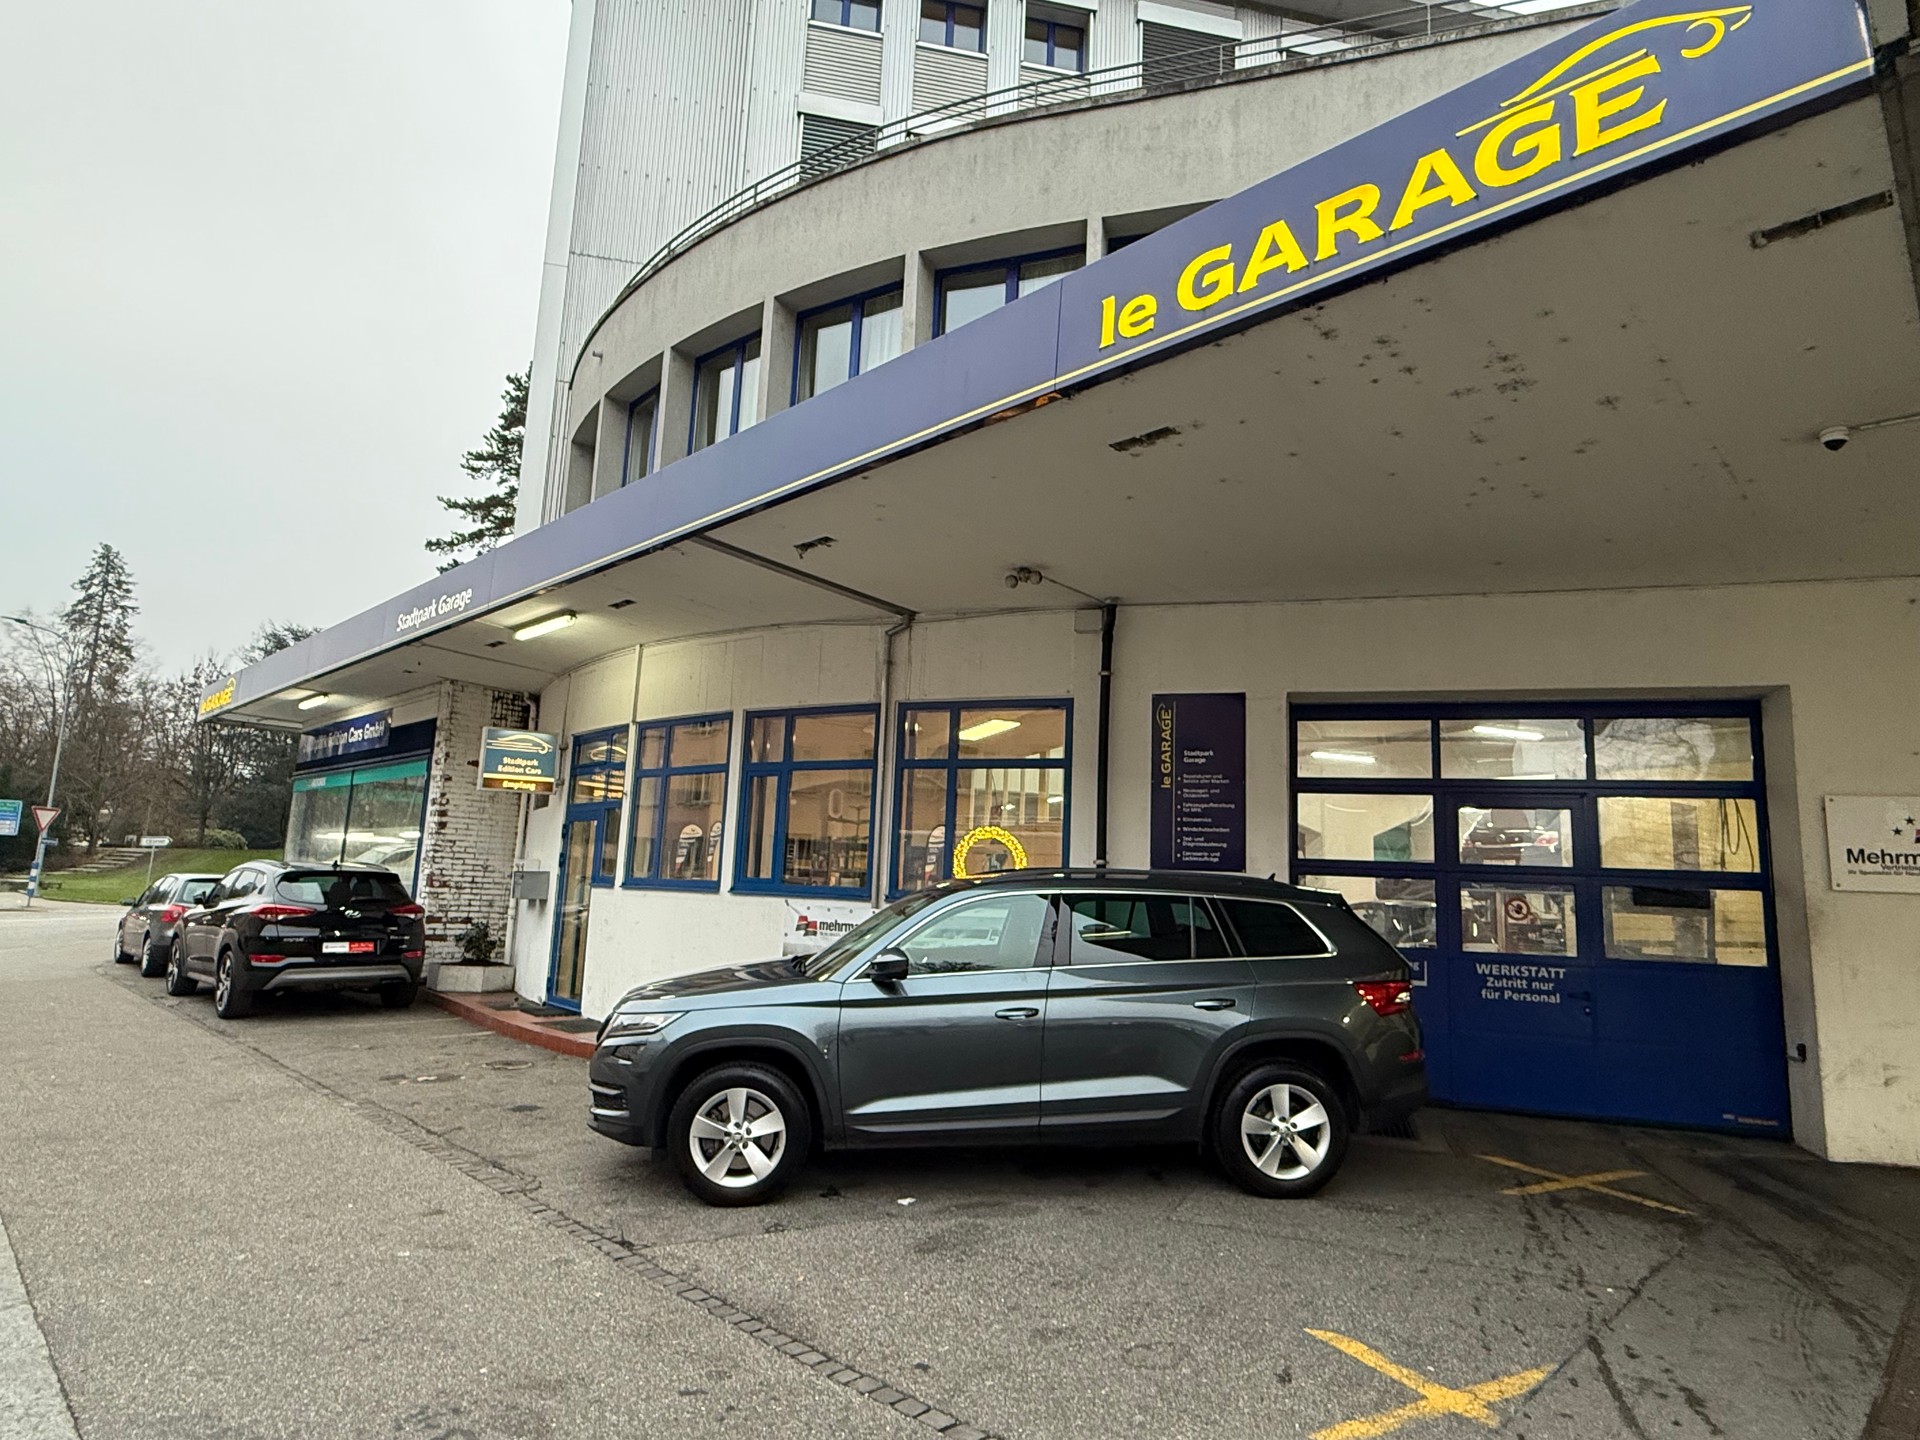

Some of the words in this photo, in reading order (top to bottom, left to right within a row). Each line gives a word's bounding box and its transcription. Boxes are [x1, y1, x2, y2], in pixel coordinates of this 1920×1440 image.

[1099, 296, 1156, 349] le
[1176, 54, 1668, 312] GARAGE
[396, 598, 437, 632] Stadtpark
[438, 588, 473, 612] Garage
[348, 727, 363, 743] Cars
[364, 720, 386, 740] GmbH
[1161, 709, 1172, 774] GARAGE
[1183, 749, 1214, 757] Stadtpark
[503, 756, 539, 766] Stadtpark
[497, 765, 524, 774] Edition
[525, 767, 542, 775] Cars
[502, 781, 536, 791] Empfang
[1161, 776, 1171, 788] le
[1475, 963, 1566, 979] WERKSTATT
[1486, 976, 1528, 989] Zutritt
[1532, 981, 1555, 991] nur
[1481, 989, 1501, 1000] für
[1503, 990, 1561, 1004] Personal
